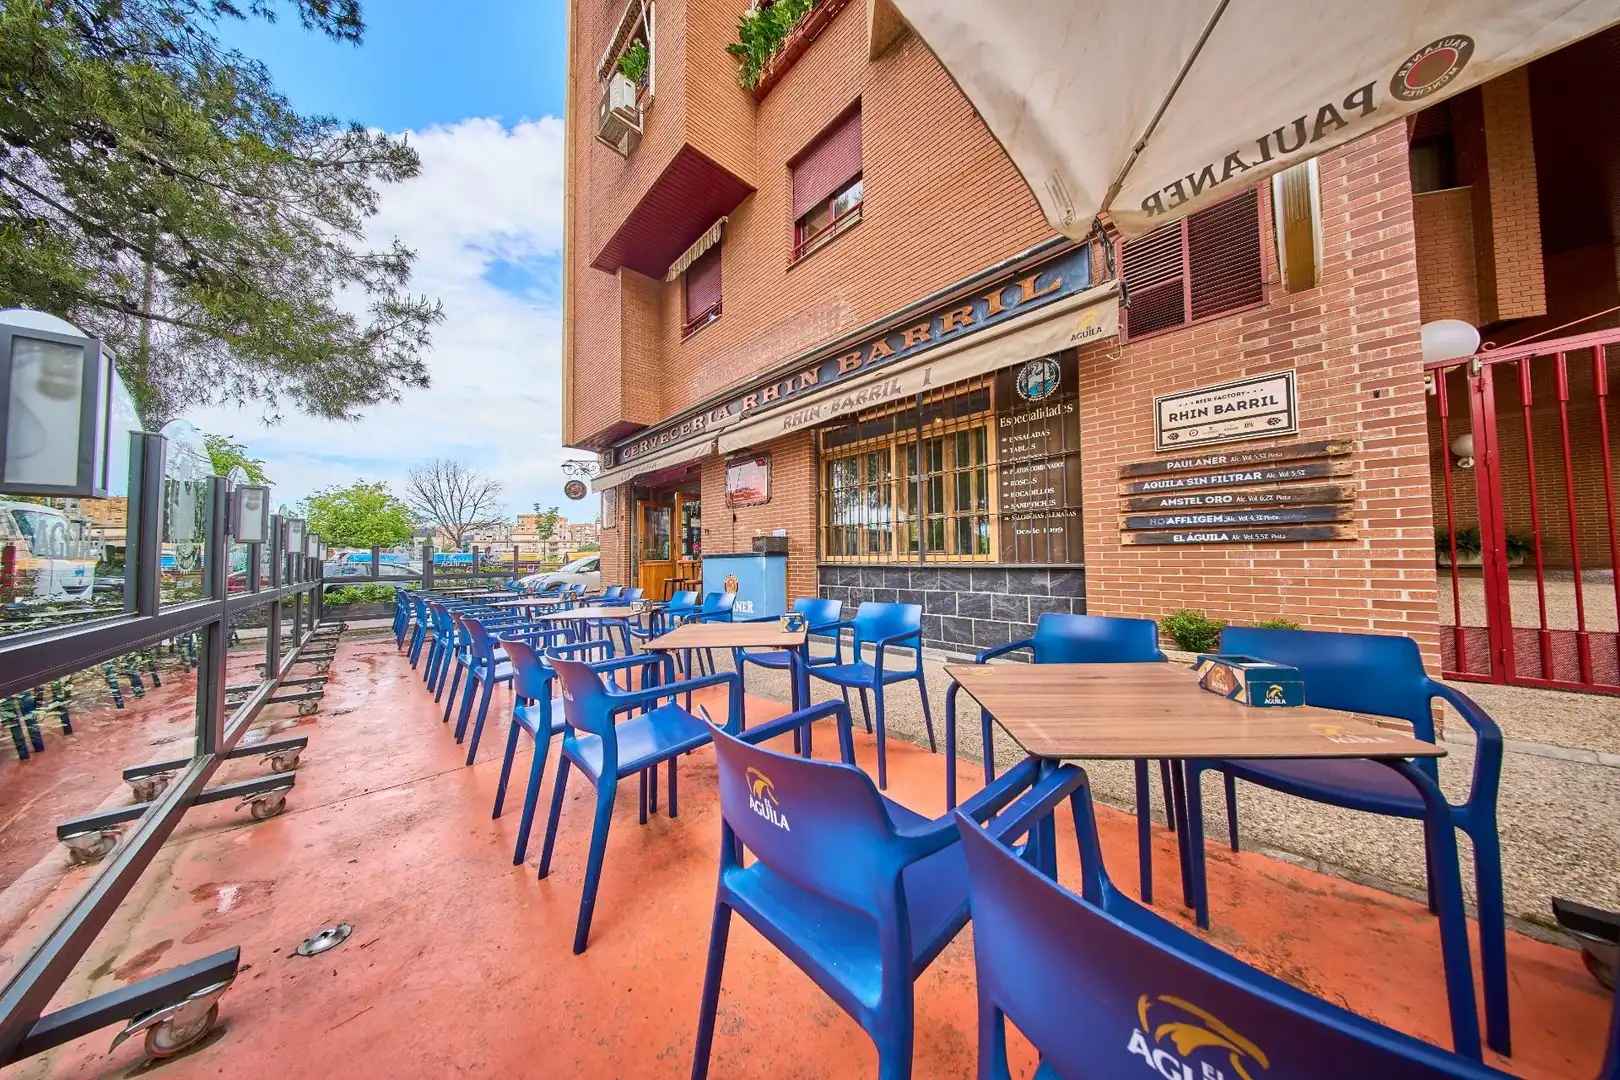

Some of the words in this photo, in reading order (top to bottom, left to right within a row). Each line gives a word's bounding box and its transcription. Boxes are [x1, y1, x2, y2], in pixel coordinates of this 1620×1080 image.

[742, 366, 822, 412] RHIN
[836, 272, 1062, 376] BARRIL
[1213, 391, 1246, 401] FACTORY
[783, 404, 822, 431] RHIN
[830, 377, 902, 415] BARRIL
[1168, 407, 1209, 423] RHIN
[1213, 395, 1279, 415] BARRIL
[1166, 456, 1227, 470] PAULANER
[1186, 476, 1208, 486] SIN
[1210, 472, 1262, 484] FILTRAR
[1160, 497, 1203, 507] AMSTEL
[1204, 495, 1233, 504] ORO
[1166, 515, 1223, 525] AFFLIGEM
[1173, 534, 1186, 542] EL
[1187, 532, 1229, 542] ÁGUILA
